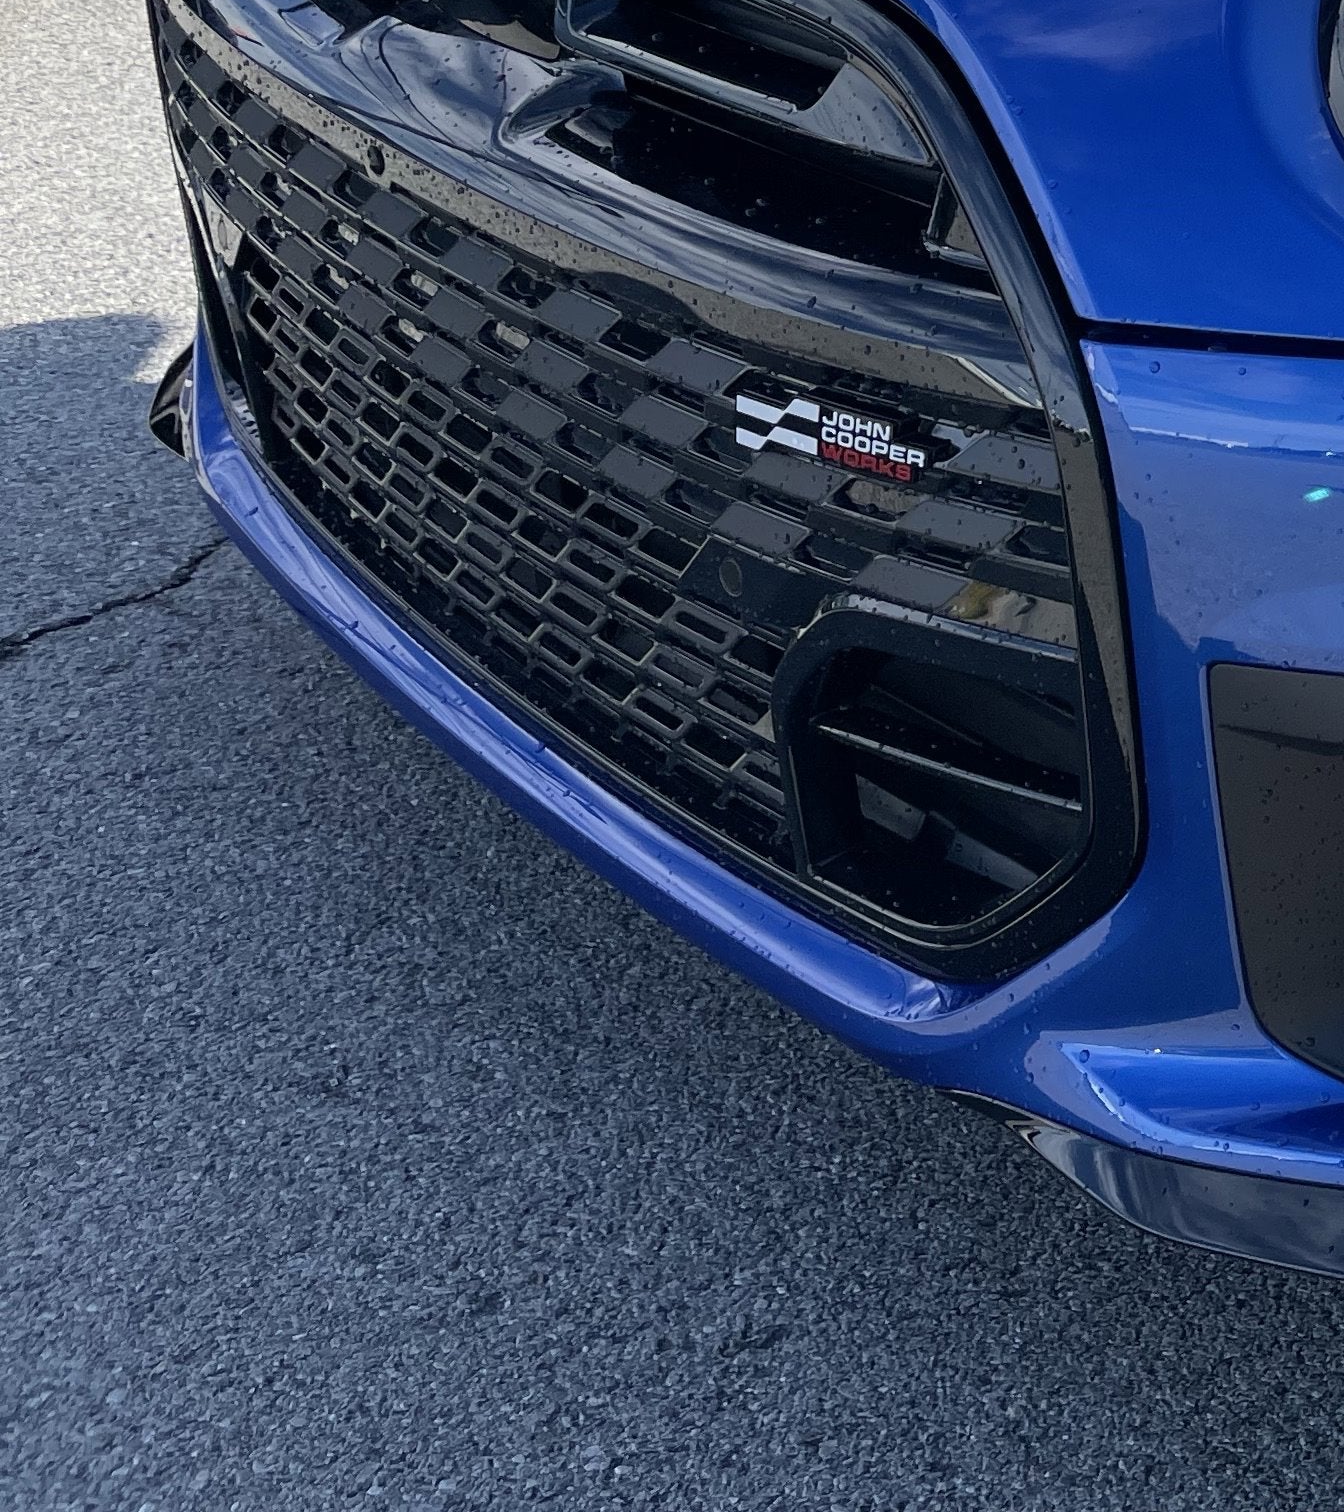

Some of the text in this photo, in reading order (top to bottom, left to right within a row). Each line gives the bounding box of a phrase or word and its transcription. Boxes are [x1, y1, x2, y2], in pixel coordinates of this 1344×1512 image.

[820, 425, 926, 468] COOPER
[821, 410, 891, 442] JOHN
[820, 441, 913, 482] WORKS
